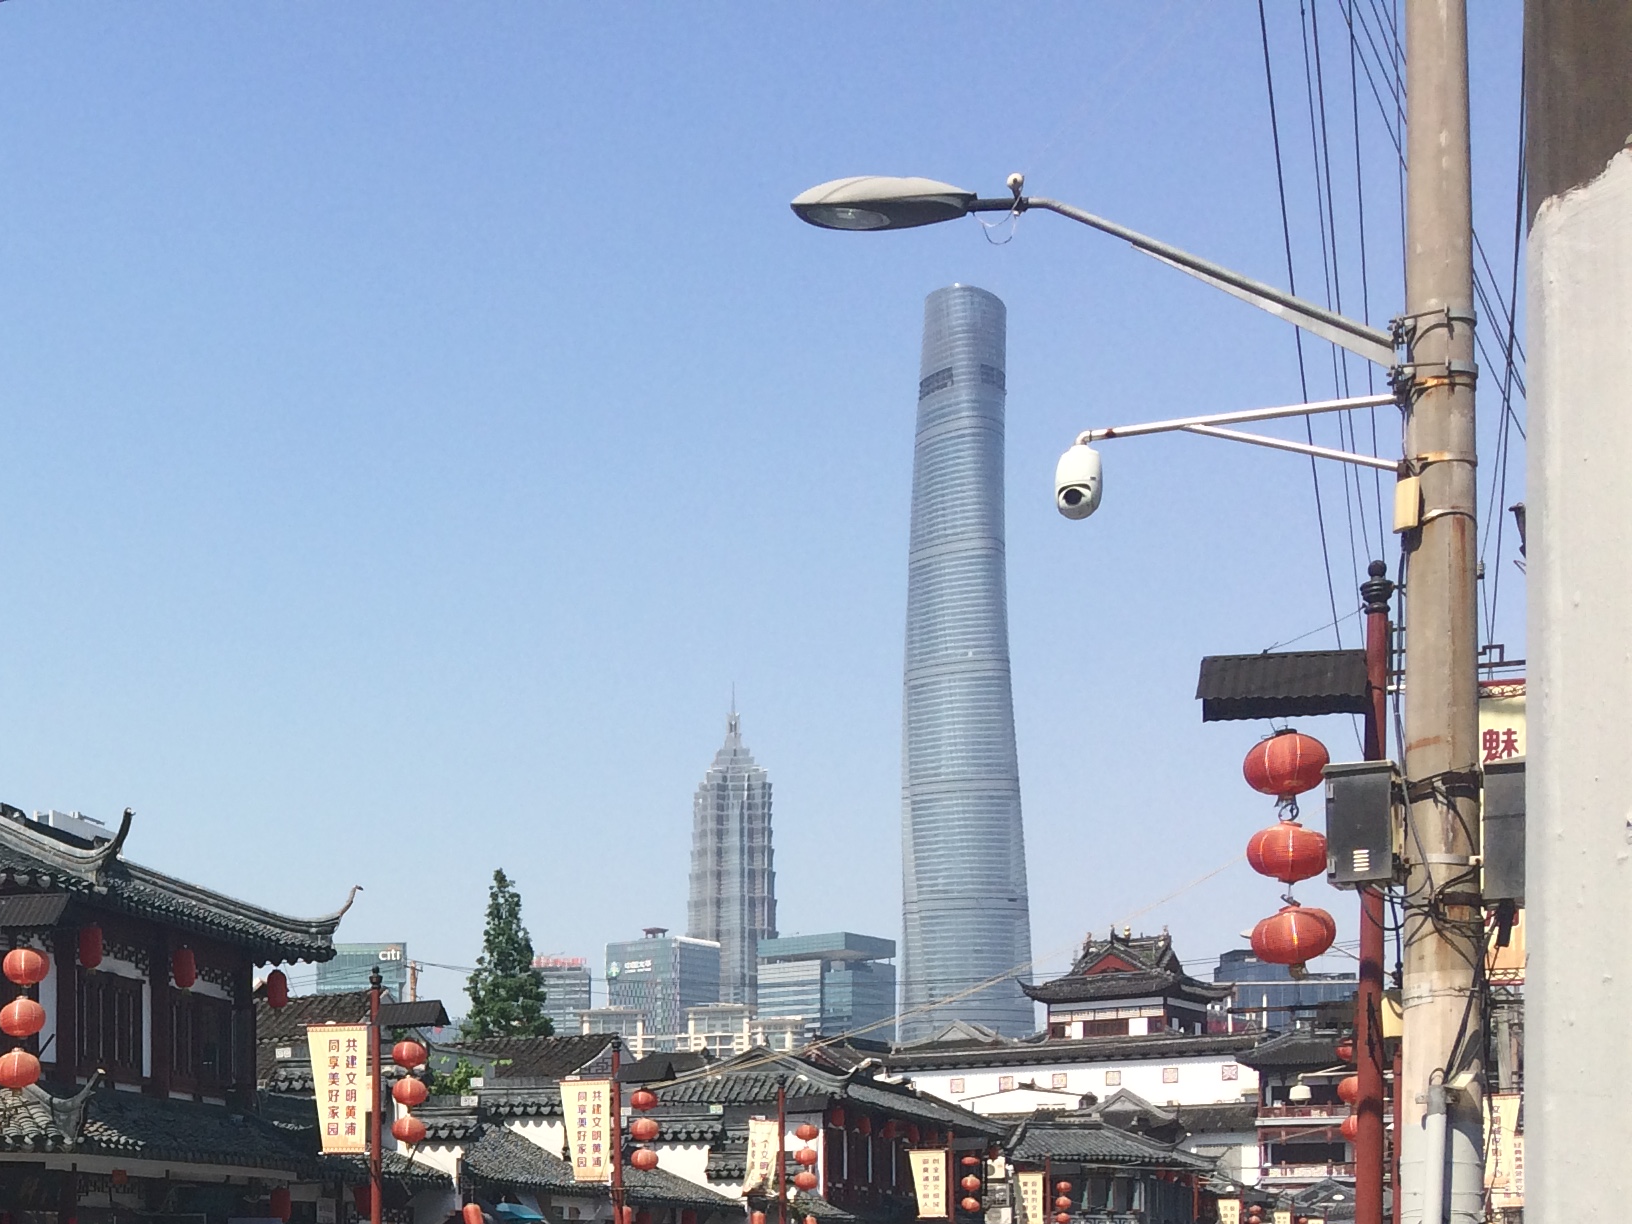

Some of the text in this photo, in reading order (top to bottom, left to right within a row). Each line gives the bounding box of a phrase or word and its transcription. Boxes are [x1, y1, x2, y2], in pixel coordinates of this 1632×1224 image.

[378, 948, 400, 961] citi
[327, 1039, 340, 1136] 同享美好家园
[344, 1038, 358, 1136] 共建文明黄浦
